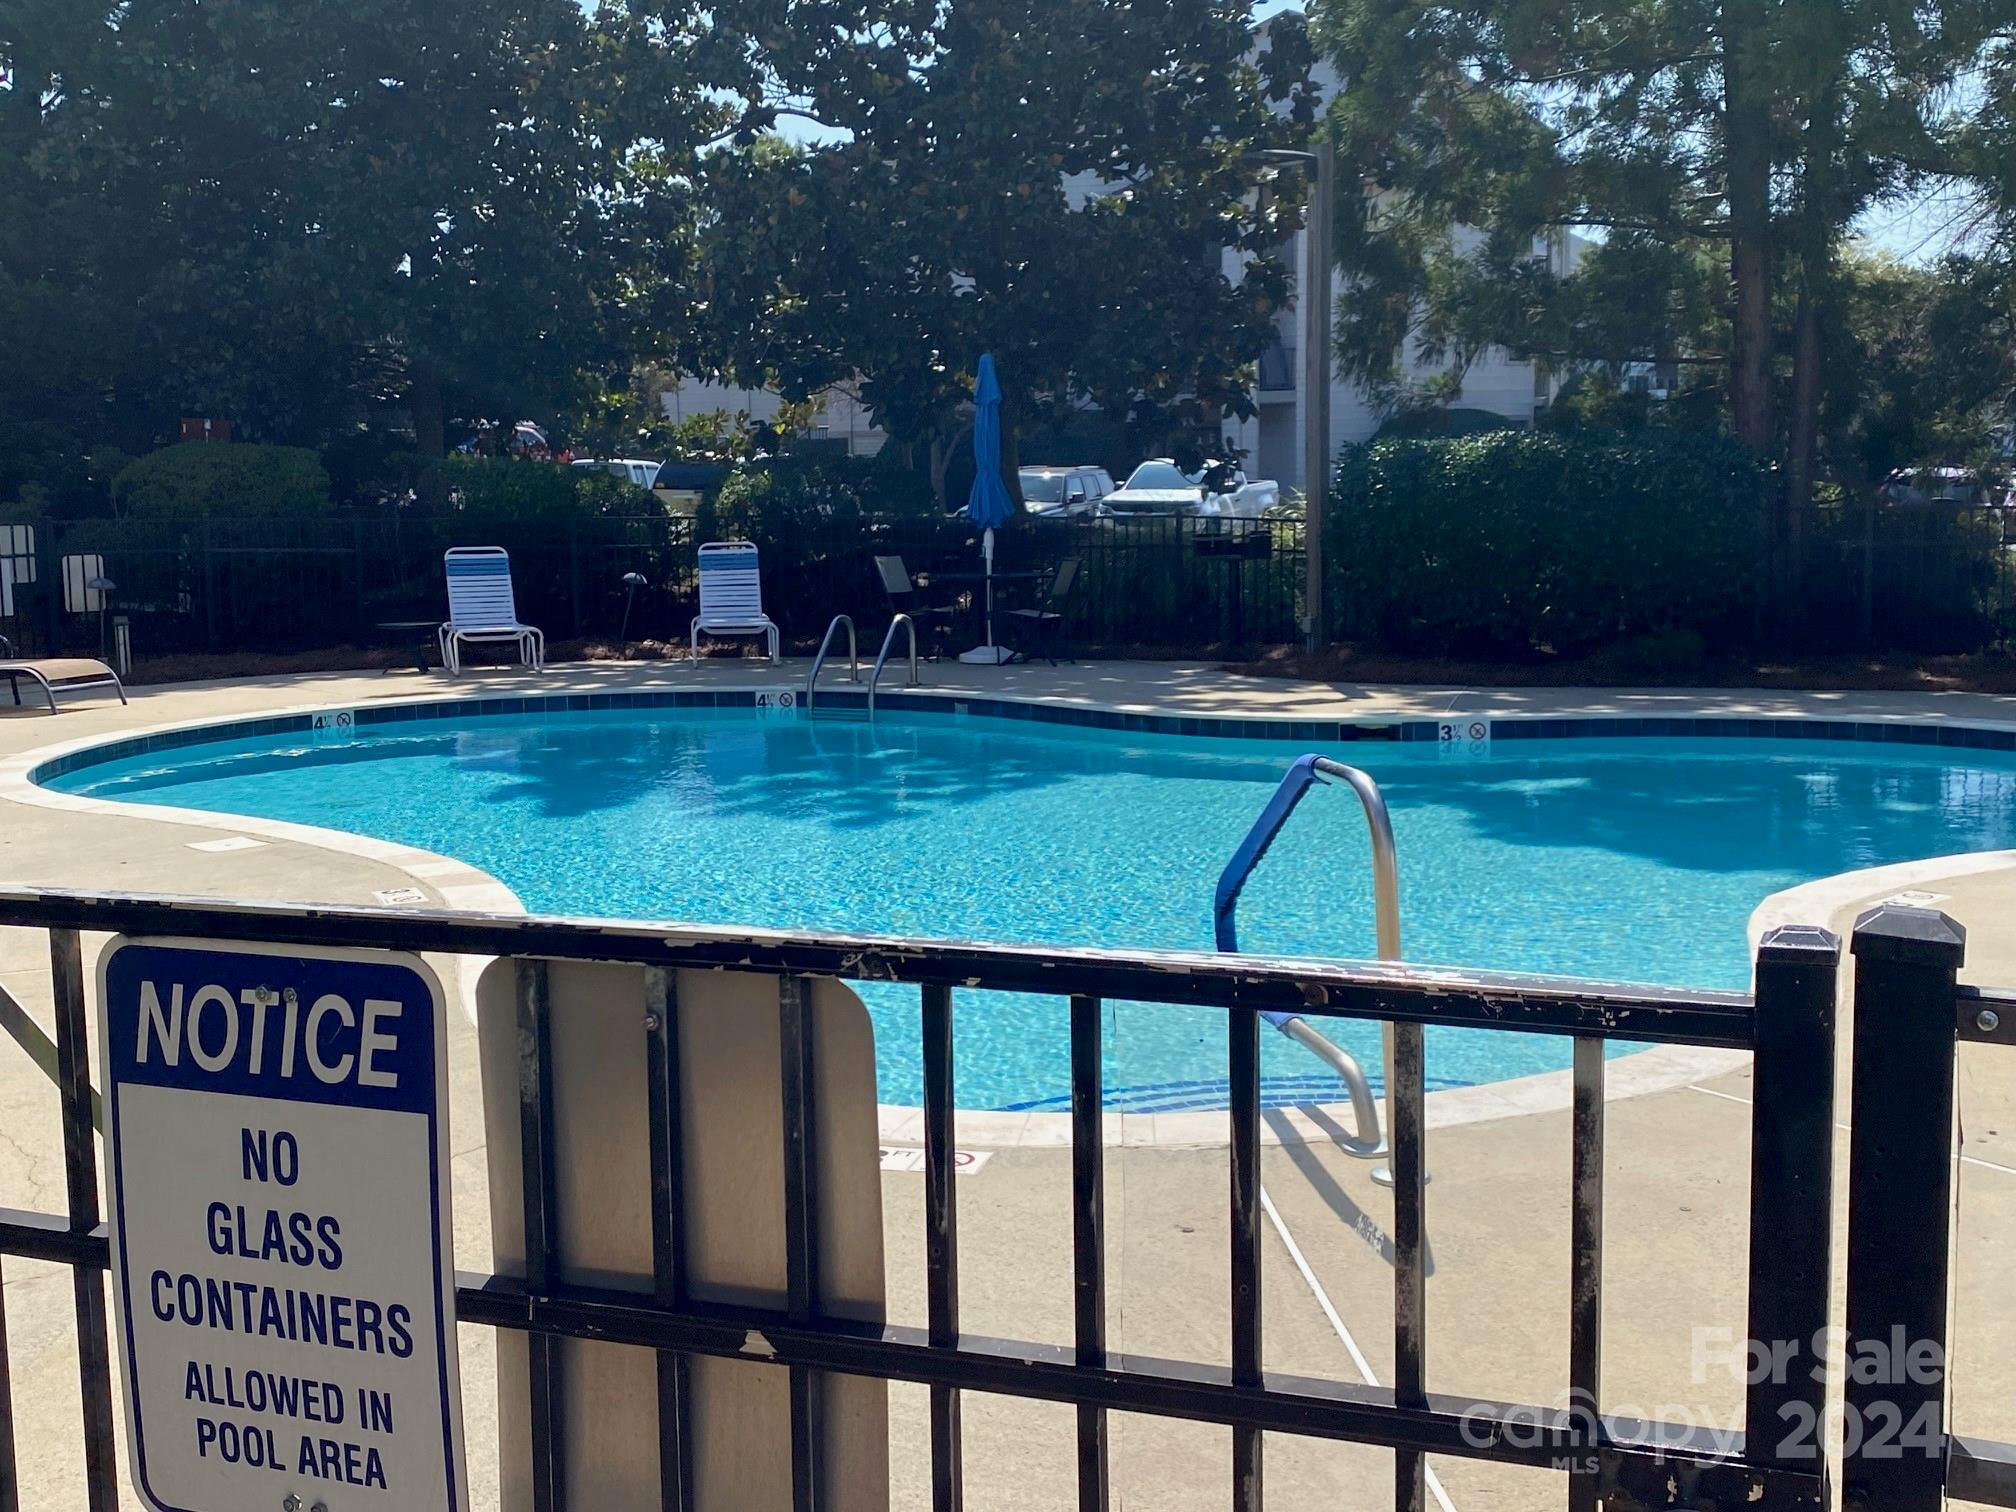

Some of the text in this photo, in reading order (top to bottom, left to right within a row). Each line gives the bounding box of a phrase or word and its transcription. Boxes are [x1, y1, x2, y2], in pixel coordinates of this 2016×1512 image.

[135, 980, 403, 1089] NOTICE
[240, 1127, 299, 1187] NO
[206, 1201, 343, 1271] GLASS
[150, 1269, 414, 1359] CONTAINERS
[184, 1360, 395, 1434] ALLOWED IN
[196, 1417, 388, 1491] POOL AREA
